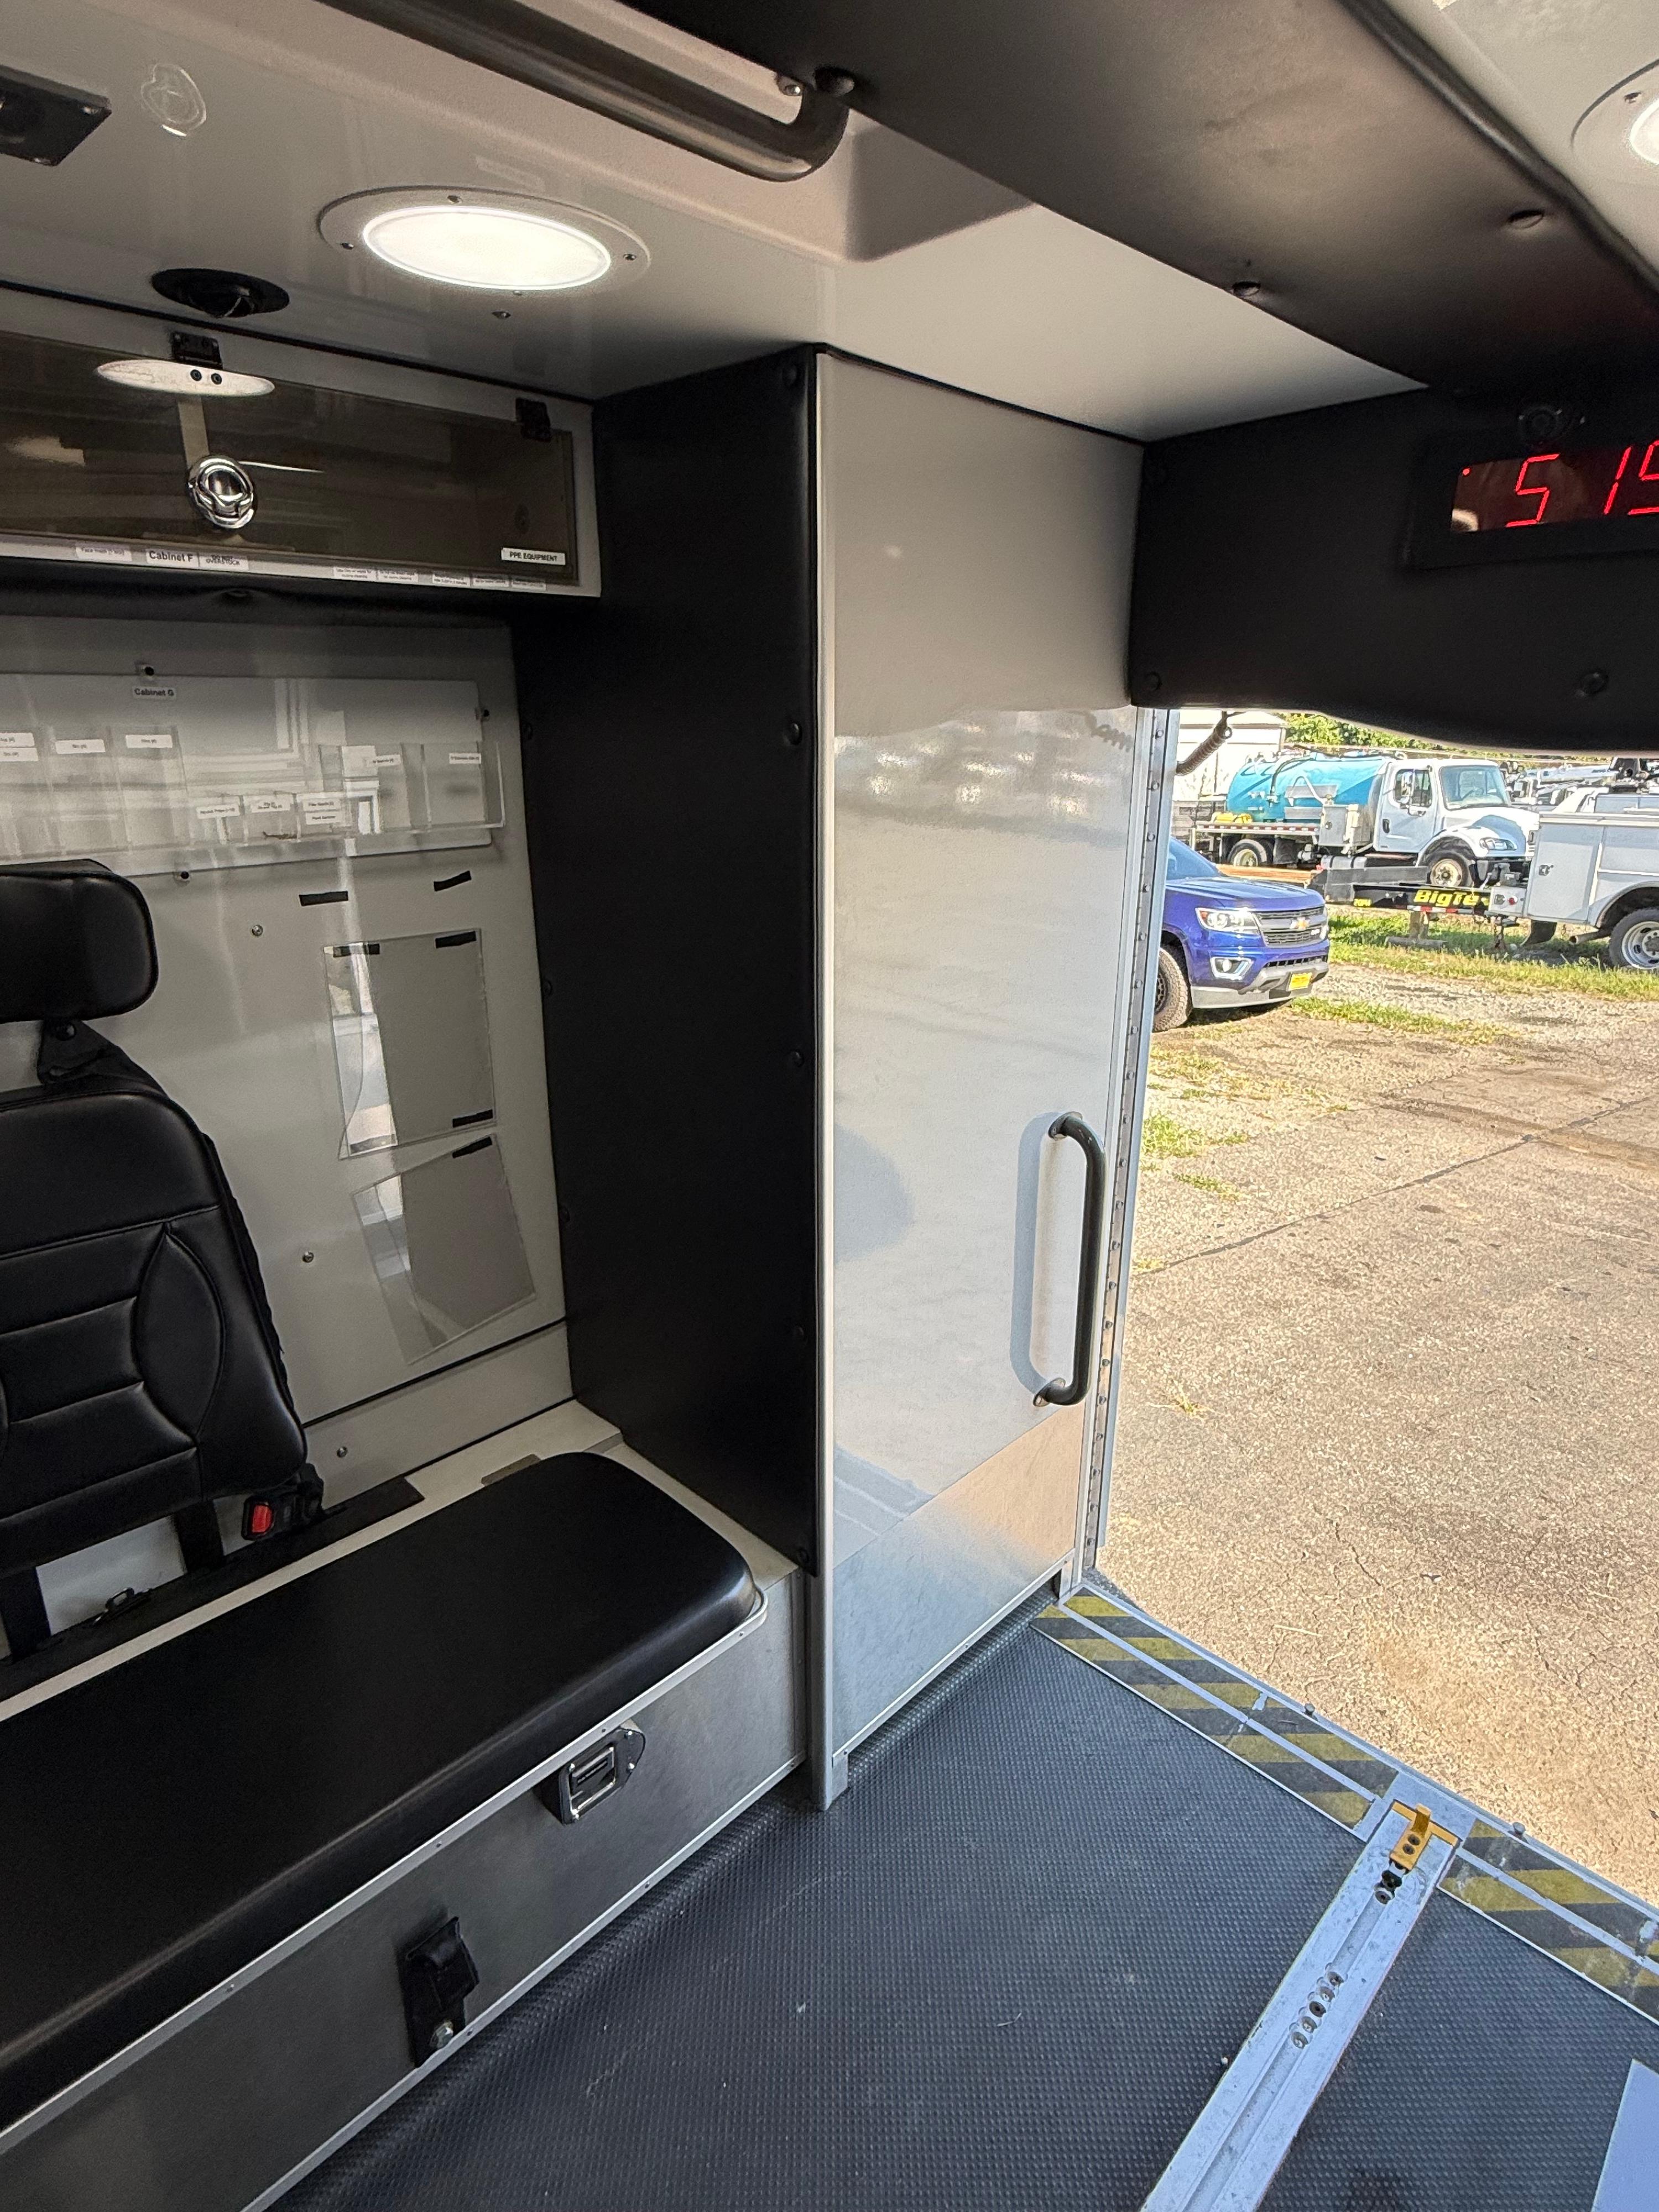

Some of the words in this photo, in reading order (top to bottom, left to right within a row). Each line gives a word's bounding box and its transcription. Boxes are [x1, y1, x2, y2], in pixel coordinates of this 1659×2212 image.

[1505, 452, 1561, 528] 5
[149, 550, 185, 562] Cabinet
[523, 552, 557, 562] EQUIPMENT
[134, 688, 166, 696] Cabinet
